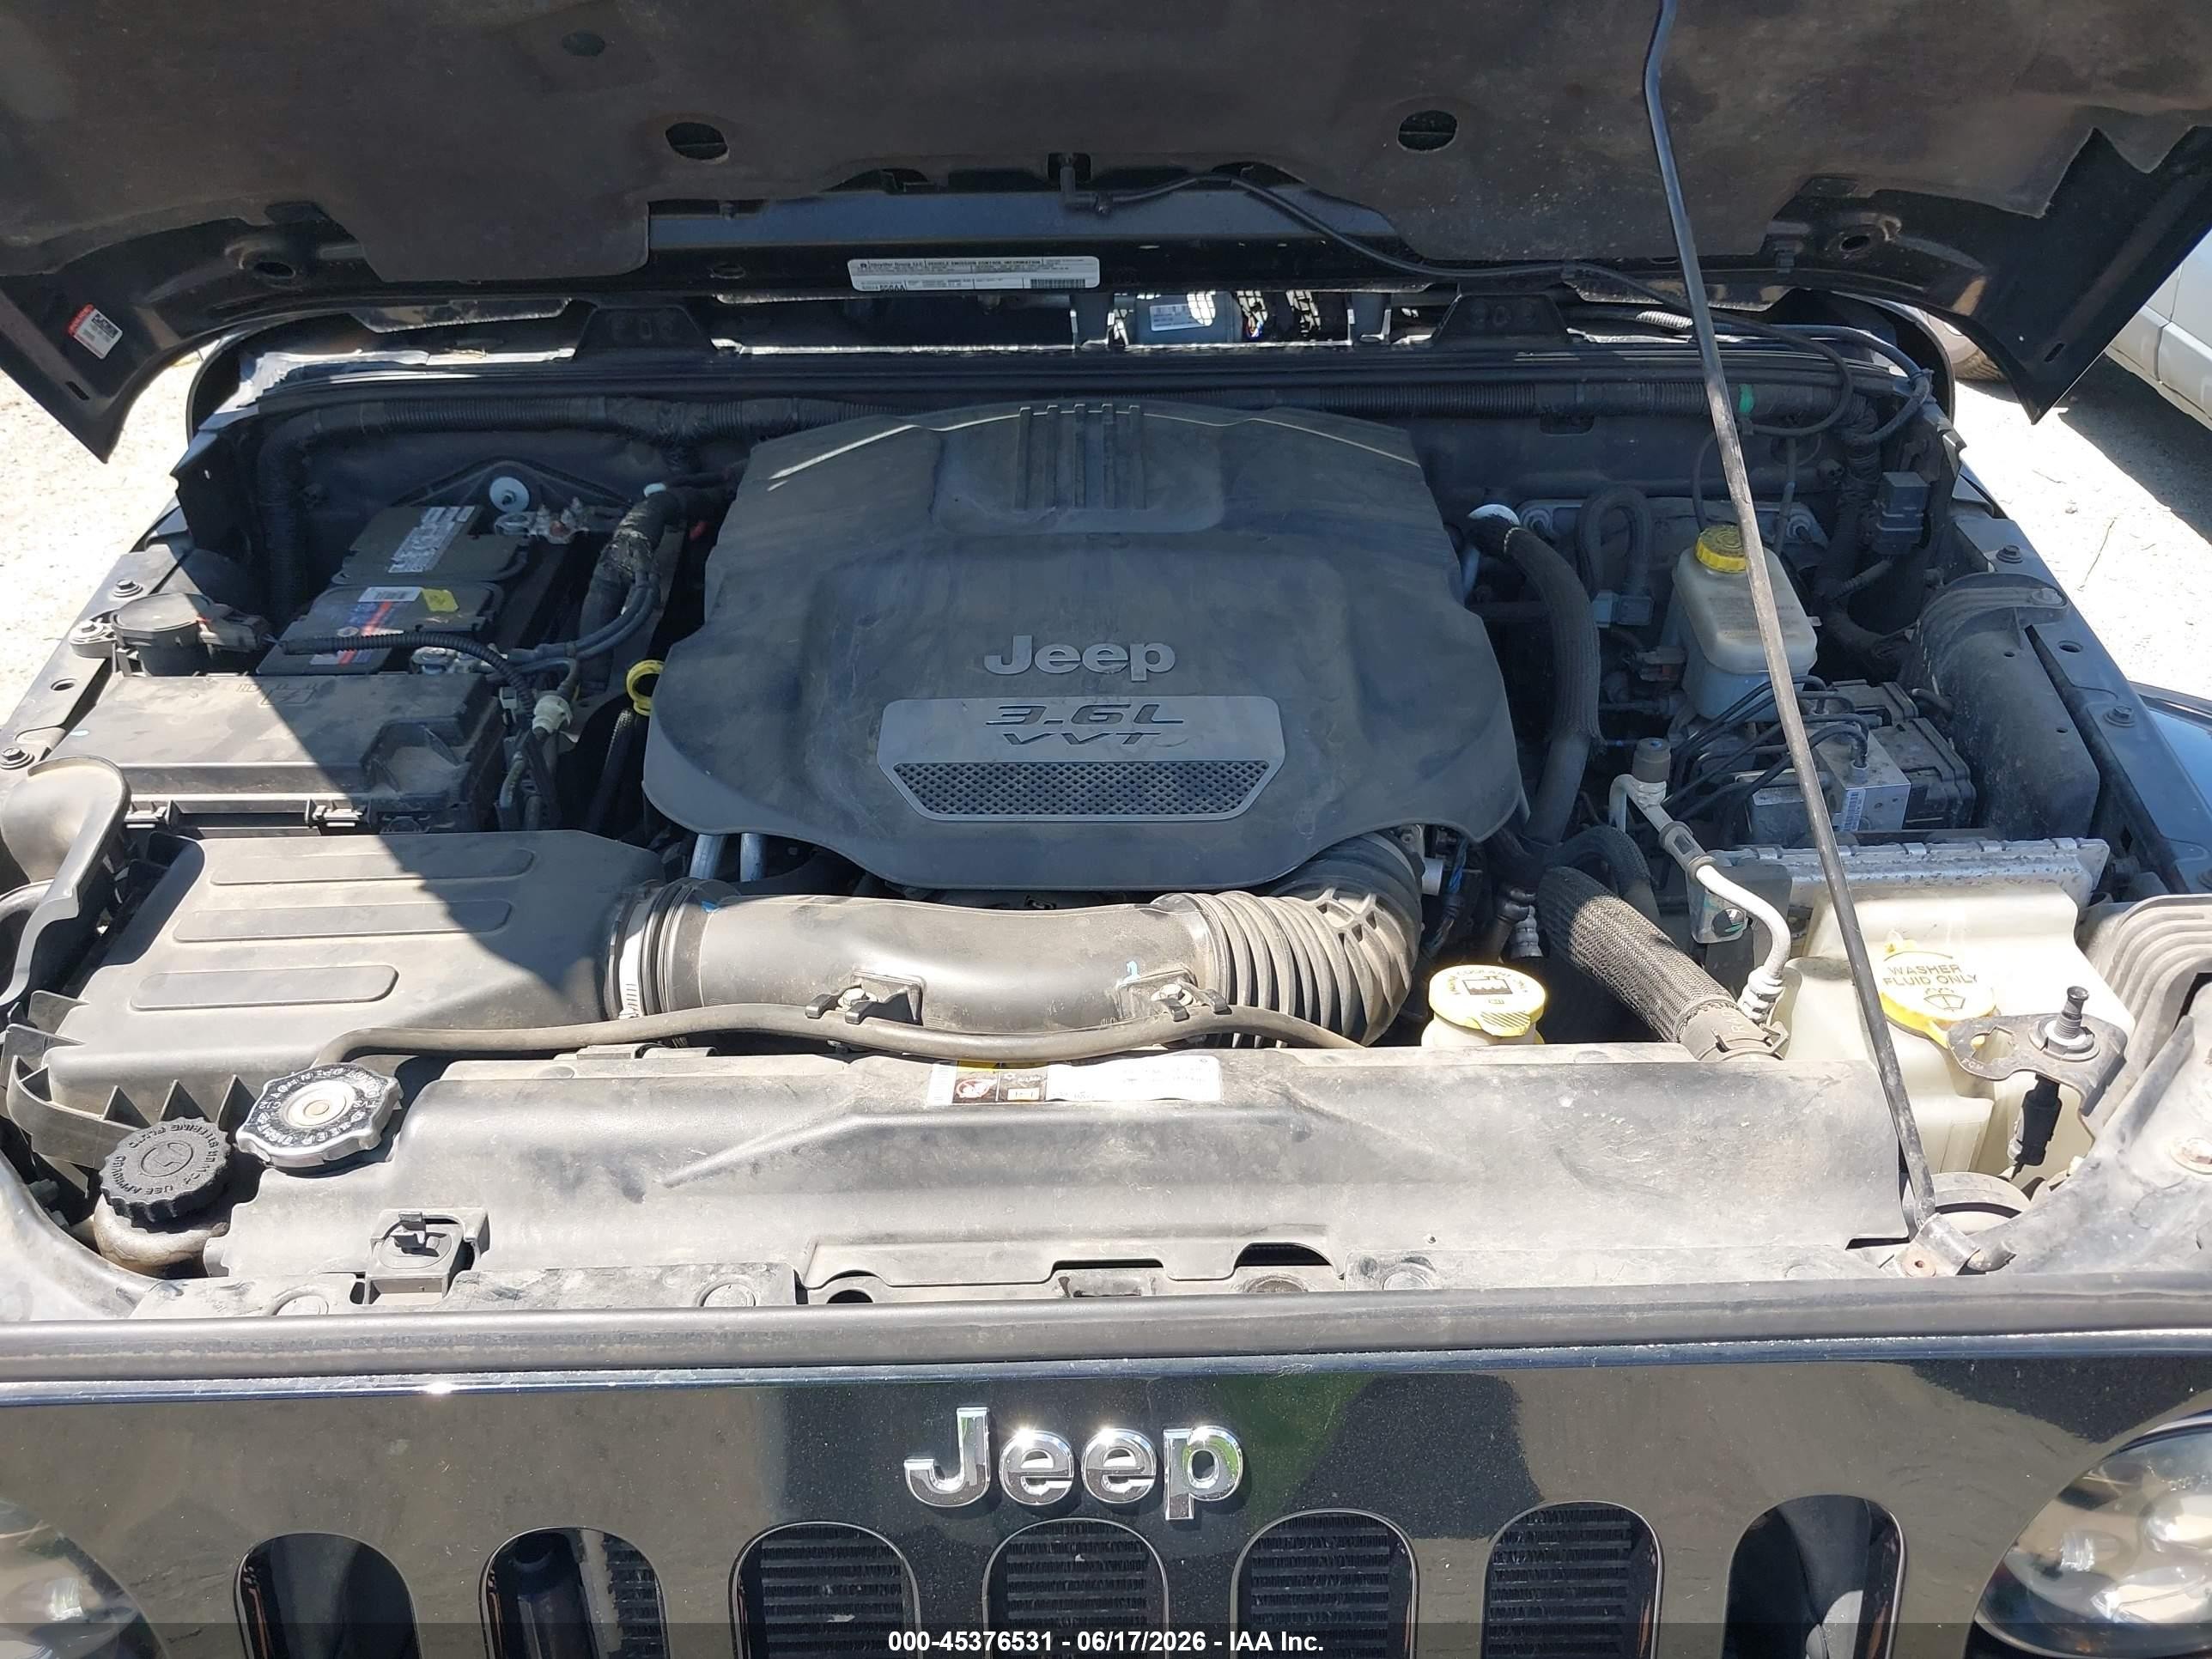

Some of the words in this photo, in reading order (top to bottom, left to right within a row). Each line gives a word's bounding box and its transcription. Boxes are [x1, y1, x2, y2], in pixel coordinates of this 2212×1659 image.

[983, 635, 1176, 682] Jeep
[985, 703, 1185, 726] 3.6L
[1002, 732, 1162, 745] VVT
[1882, 975, 1932, 987] FLUID
[1936, 974, 1978, 985] ONLY
[1887, 963, 1962, 976] WASHER
[170, 1123, 220, 1150] STEERING
[256, 1122, 295, 1146] TIGHT
[301, 1121, 352, 1146] KEEP
[111, 1155, 143, 1195] APPROVED
[183, 1150, 218, 1185] POWER
[144, 1185, 174, 1195] USE
[903, 1407, 1243, 1521] Jeep
